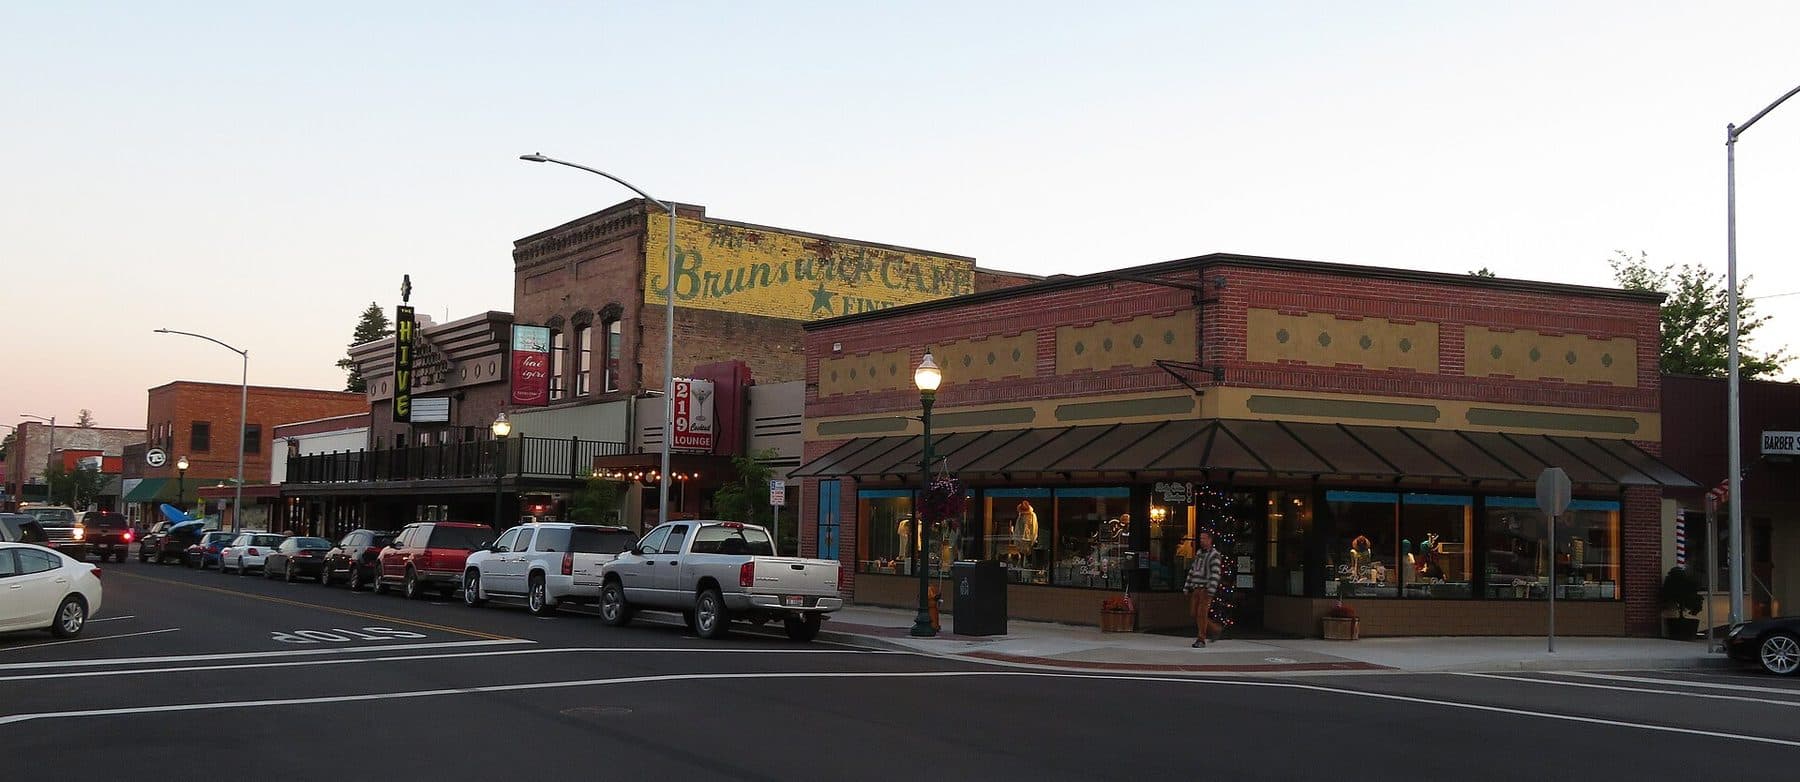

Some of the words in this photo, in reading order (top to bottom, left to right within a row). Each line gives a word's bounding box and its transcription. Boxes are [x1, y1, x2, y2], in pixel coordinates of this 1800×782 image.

[651, 244, 874, 300] Brunswick
[397, 320, 411, 416] HIVE
[676, 383, 688, 432] 219
[675, 436, 711, 446] LOUNGE
[1765, 436, 1794, 450] BARBER
[271, 626, 428, 644] STOP
